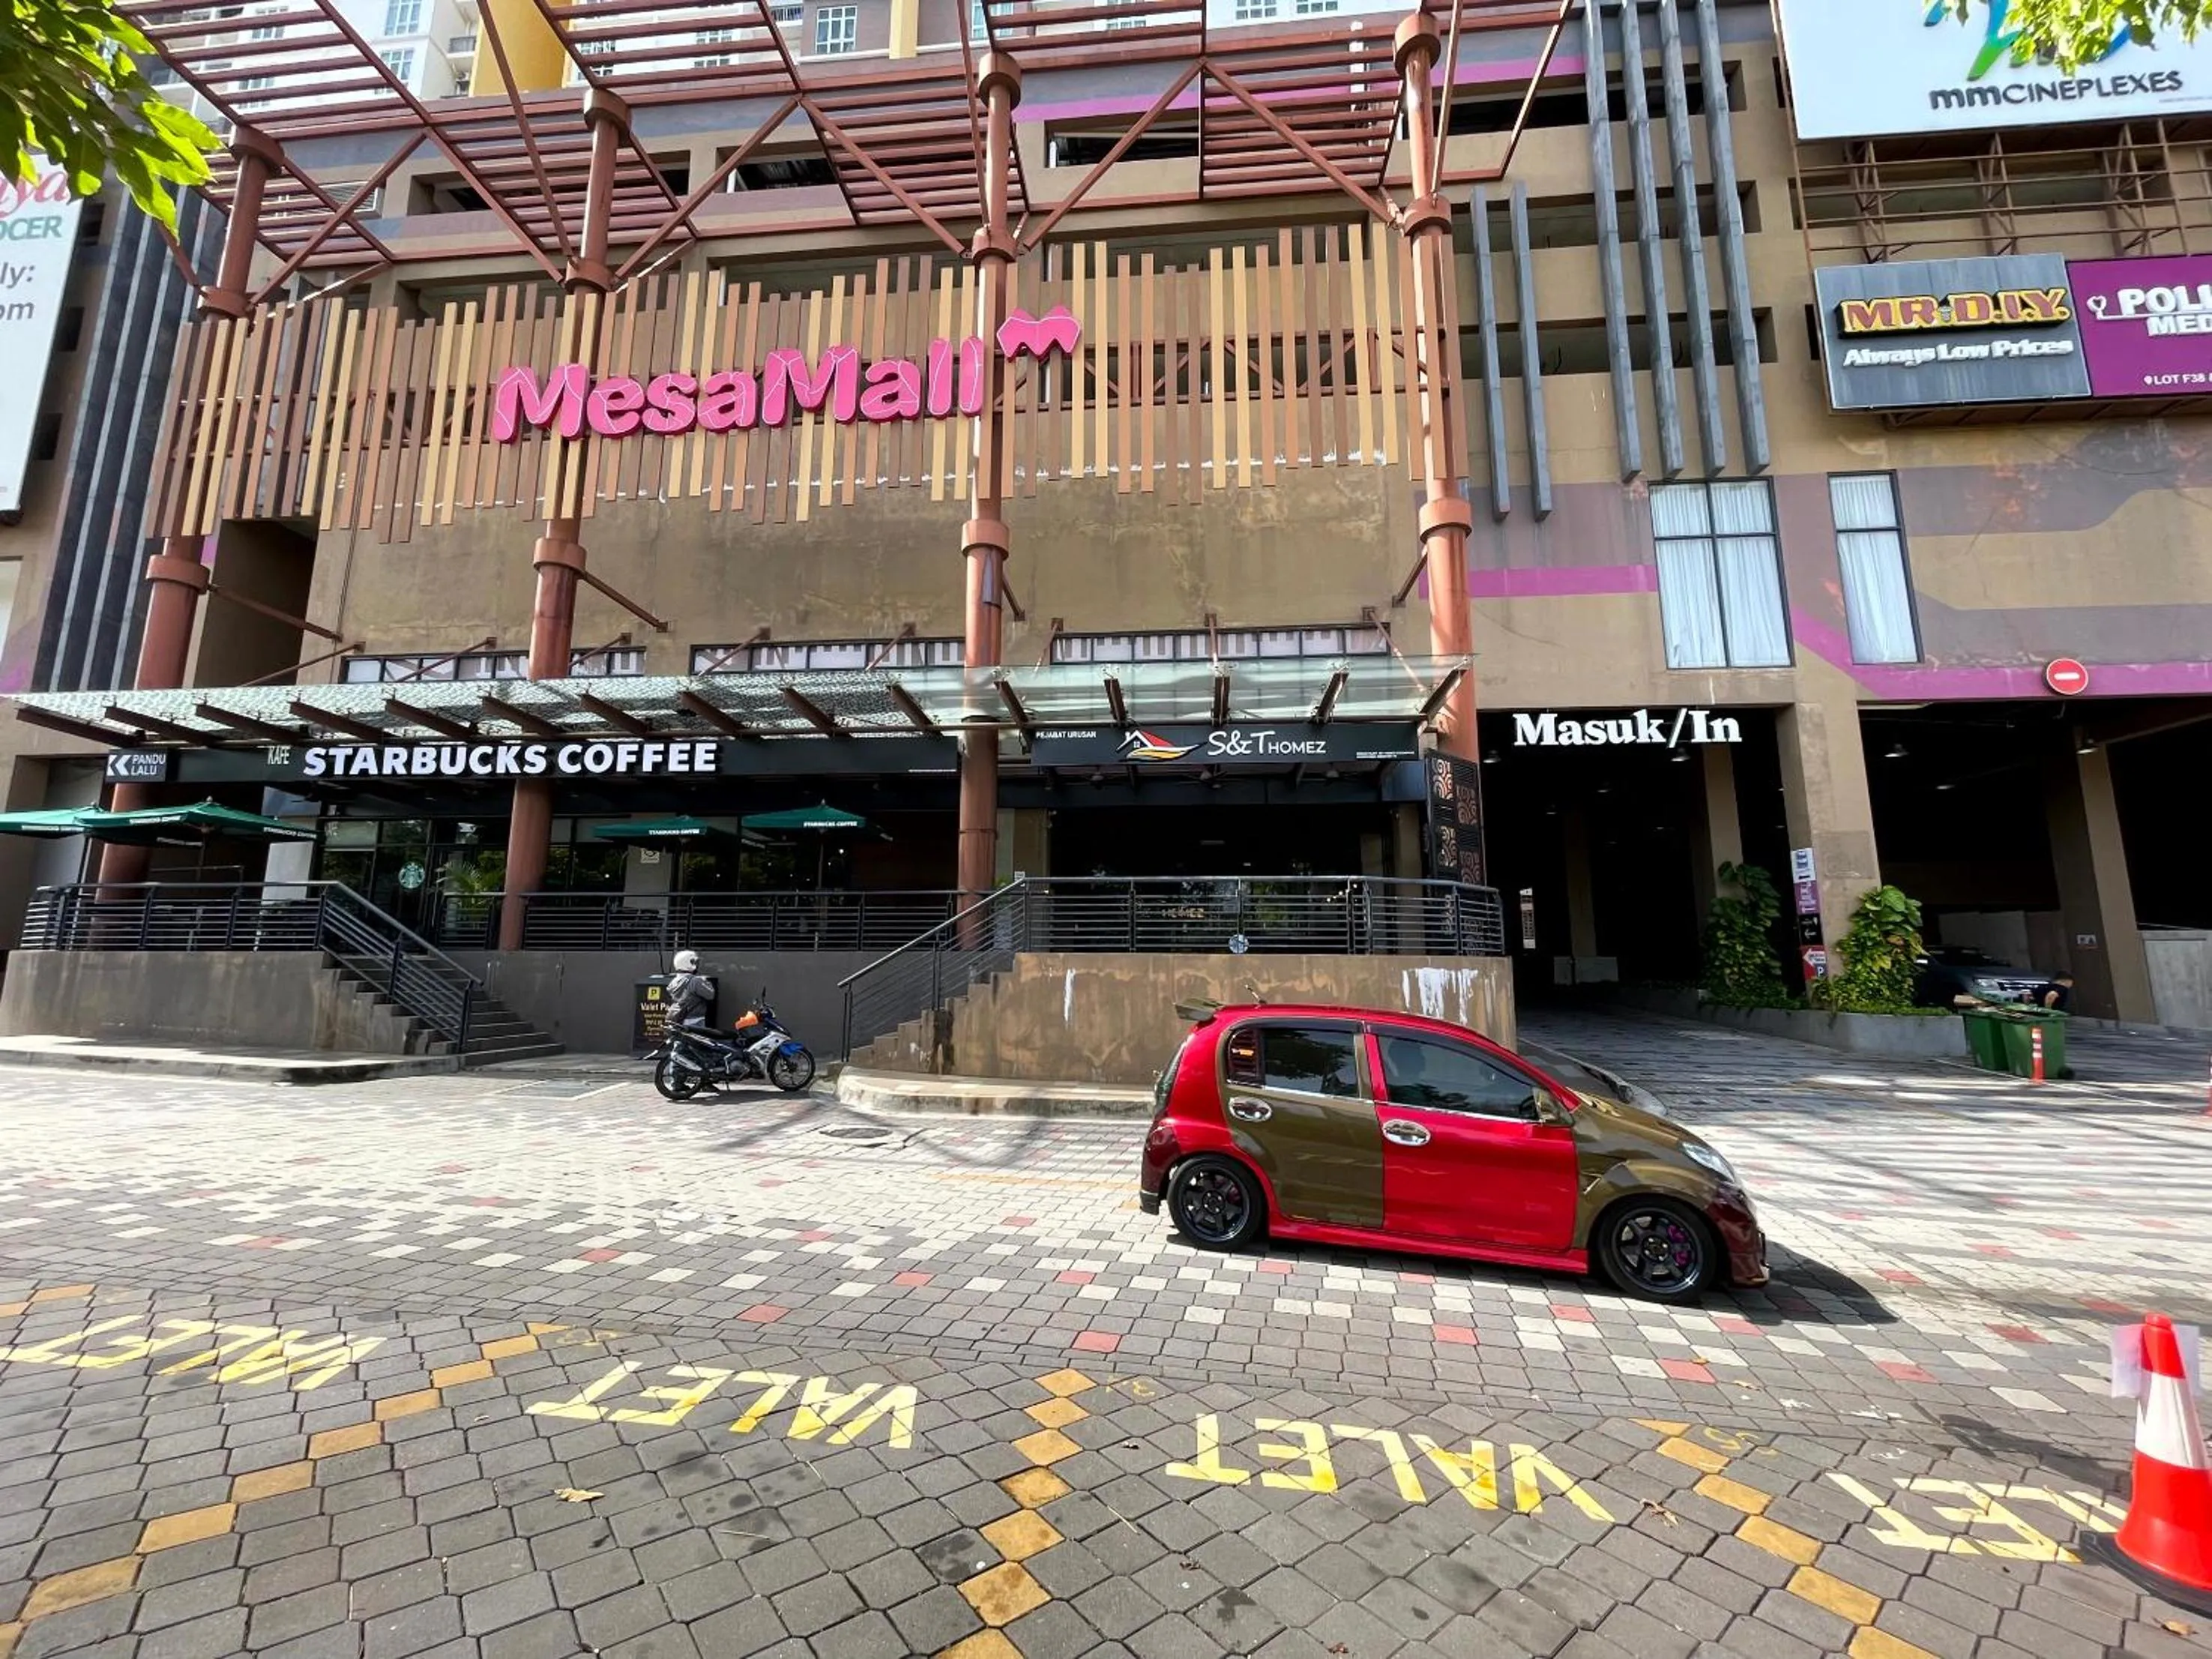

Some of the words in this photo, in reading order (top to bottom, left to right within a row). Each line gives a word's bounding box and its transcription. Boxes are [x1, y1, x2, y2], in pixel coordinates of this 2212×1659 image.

[1843, 348, 1936, 367] Always
[1936, 343, 1990, 361] Low
[1991, 340, 2074, 358] Prices
[492, 335, 984, 445] MesaMall
[2154, 376, 2178, 385] LOT
[1513, 708, 1742, 748] Masuk/In
[133, 753, 166, 765] PANDU
[267, 745, 291, 765] KAFE
[304, 744, 547, 775] STARBUCKS
[558, 743, 717, 773] COFFEE
[130, 765, 158, 776] LALU
[525, 1361, 918, 1449] VALET
[1165, 1413, 1616, 1523] VALET
